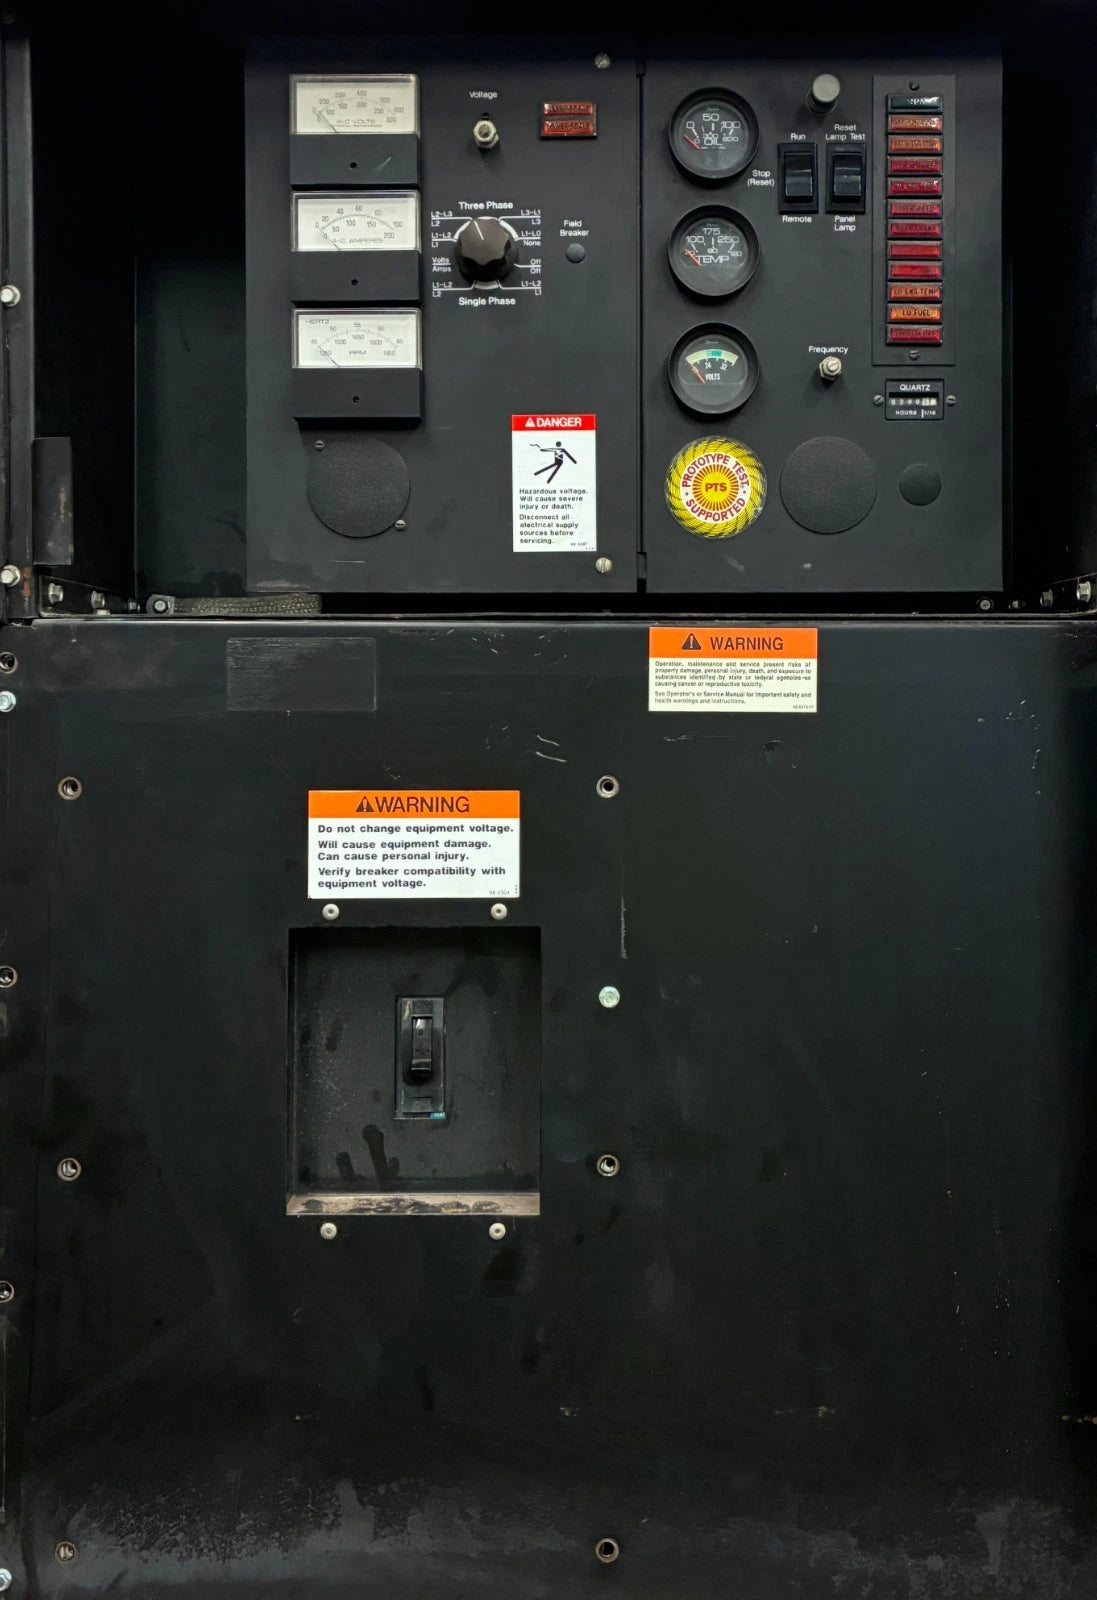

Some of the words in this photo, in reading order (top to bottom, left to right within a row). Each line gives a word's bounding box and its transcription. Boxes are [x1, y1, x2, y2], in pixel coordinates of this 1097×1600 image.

[470, 91, 498, 99] Voltage
[826, 133, 846, 141] Lamp
[752, 170, 770, 178] Stop
[747, 179, 775, 188] (Reset)
[486, 202, 514, 210] Phase
[834, 224, 856, 232] Lamp
[717, 236, 740, 244] 250
[696, 256, 730, 264] TEMP
[458, 297, 486, 306] Single
[488, 297, 516, 305] Phase
[808, 345, 848, 354] Frequency
[900, 384, 931, 392] QUARTZ
[536, 417, 582, 428] DANGER
[682, 453, 730, 488] PROTOTYPE
[732, 460, 750, 486] TEST
[705, 482, 728, 492] PTS
[560, 488, 588, 497] voltage.
[686, 498, 746, 522] SUPPORTED
[710, 636, 784, 650] WARNING
[374, 796, 470, 813] WARNING
[318, 825, 332, 833] Do
[337, 825, 355, 833] not
[360, 824, 400, 834] change
[406, 824, 464, 834] equipment
[470, 824, 514, 834] voltage.
[318, 840, 338, 849] Will
[342, 841, 376, 849] cause
[380, 840, 440, 850] equipment
[444, 840, 492, 850] damage.
[318, 852, 340, 861] Can
[344, 852, 378, 860] cause
[382, 852, 430, 862] personal
[434, 852, 470, 862] injury.
[318, 867, 350, 878] Verify
[355, 867, 398, 876] breaker
[404, 866, 476, 878] compatibility
[482, 866, 506, 875] with
[318, 880, 378, 890] equipment
[382, 879, 426, 890] voltage.
